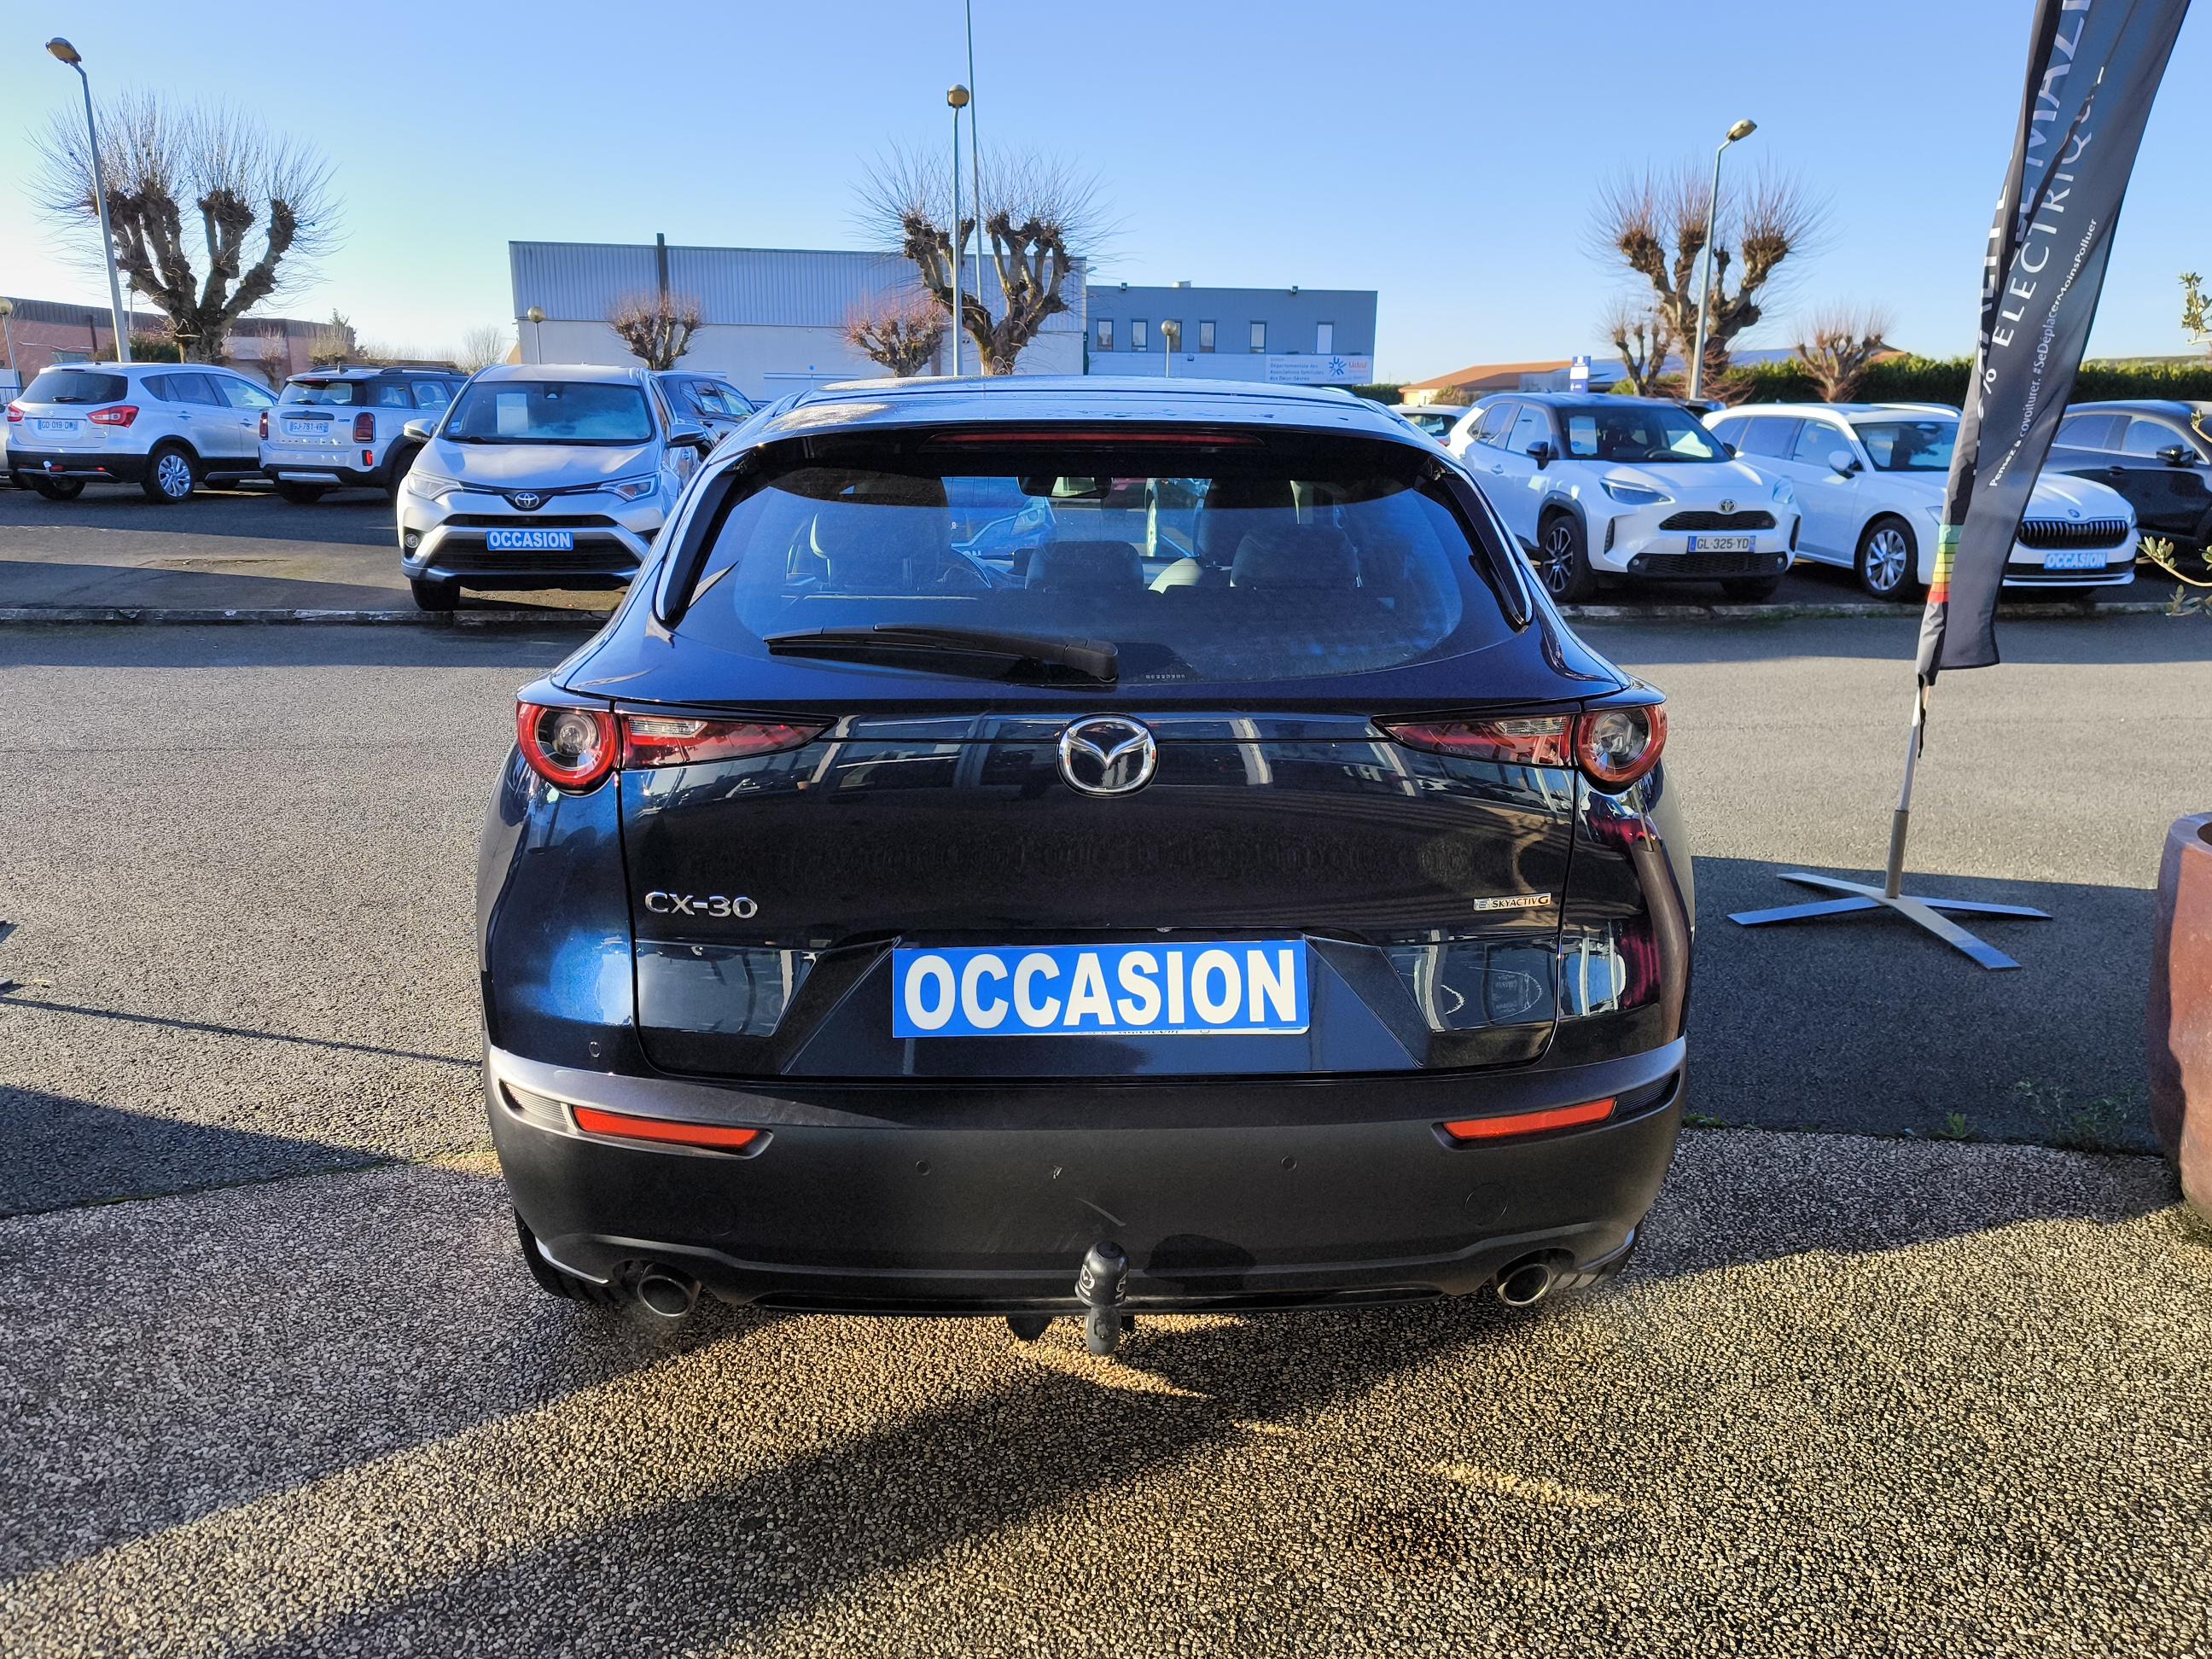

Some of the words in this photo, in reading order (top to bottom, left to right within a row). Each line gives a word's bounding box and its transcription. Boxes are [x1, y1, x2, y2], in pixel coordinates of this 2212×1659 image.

[2019, 378, 2041, 438] covoiturer.
[489, 531, 571, 548] OCCASION
[2047, 552, 2106, 568] OCCASION
[644, 891, 758, 919] CX-30
[904, 949, 1296, 1030] OCCASION
